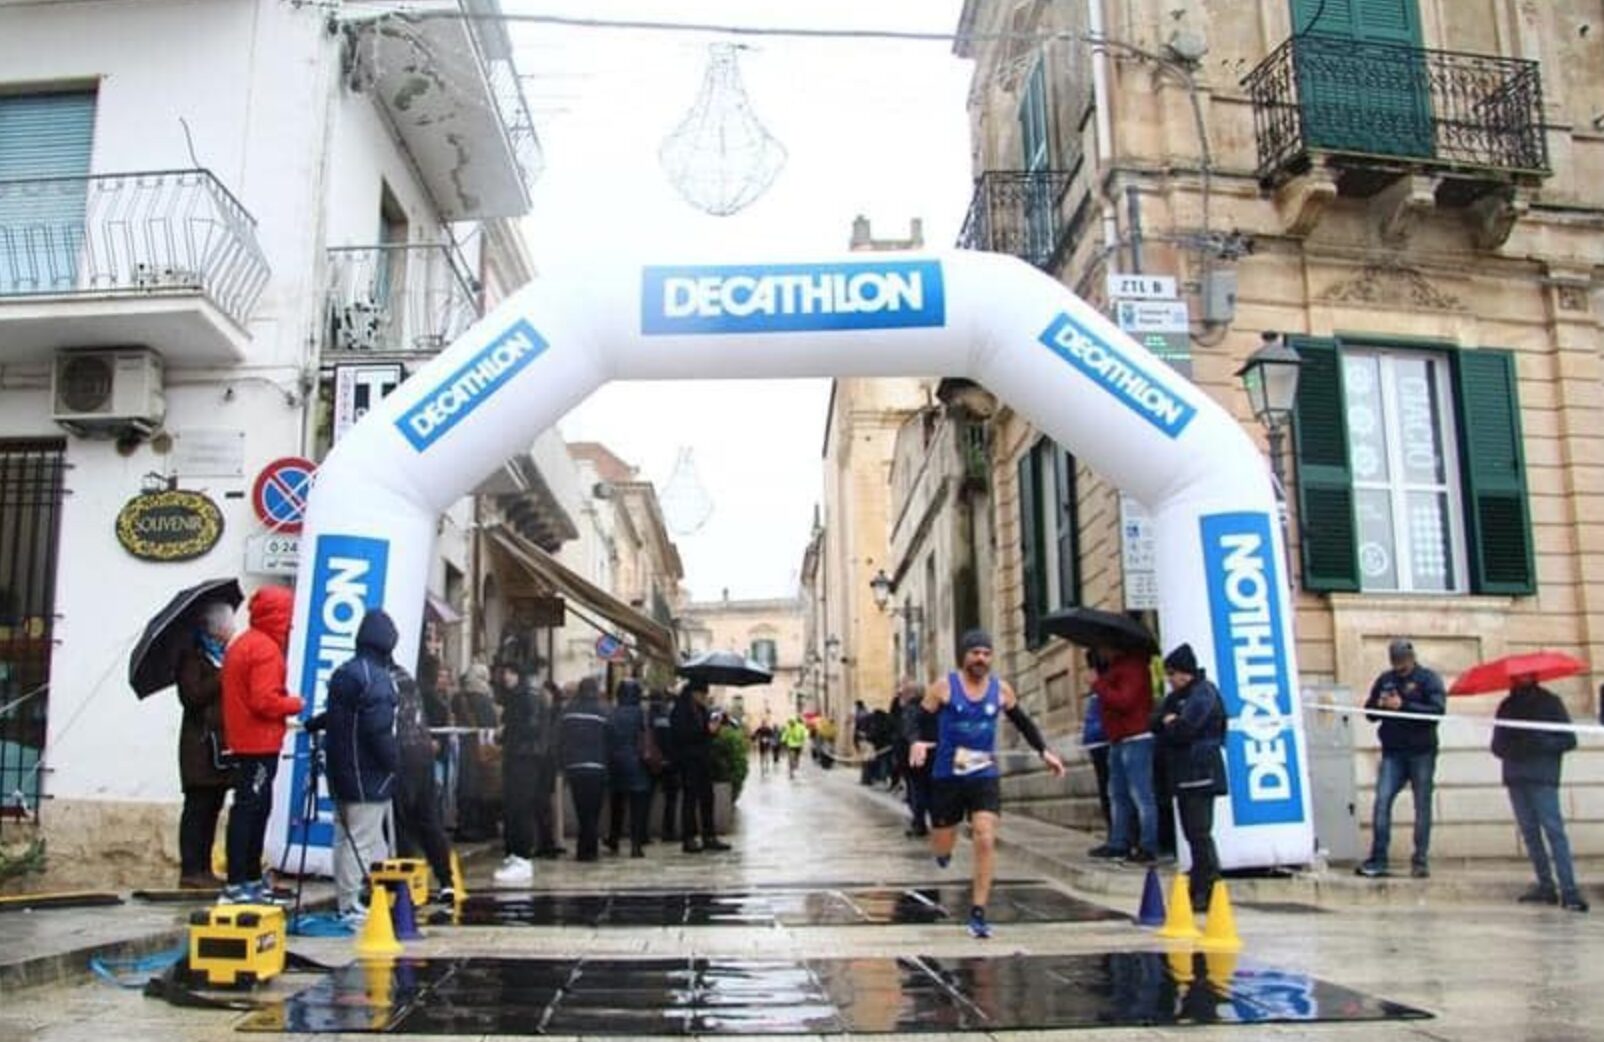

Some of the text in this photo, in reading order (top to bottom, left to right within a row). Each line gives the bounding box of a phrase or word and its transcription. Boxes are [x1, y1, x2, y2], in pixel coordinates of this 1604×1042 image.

[664, 271, 923, 317] DECATHLON
[409, 331, 535, 438] DECATHLON
[1054, 324, 1185, 425] DECATHLON
[135, 515, 203, 533] SOUVENIR
[1220, 533, 1291, 802] DECATHLON
